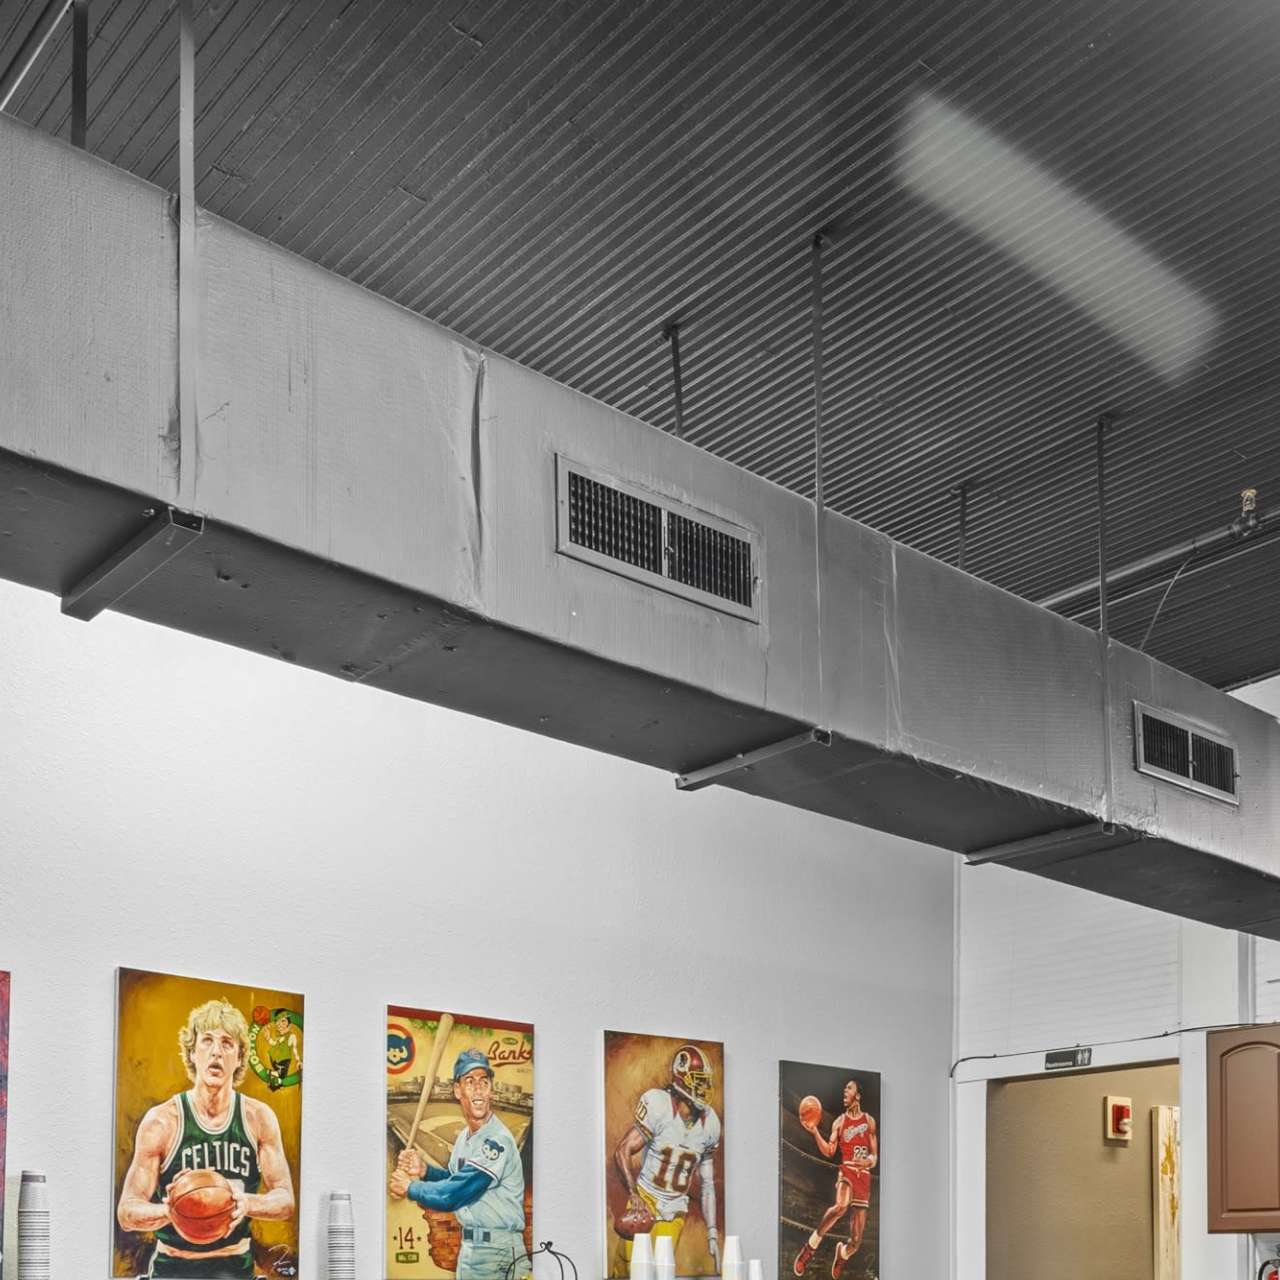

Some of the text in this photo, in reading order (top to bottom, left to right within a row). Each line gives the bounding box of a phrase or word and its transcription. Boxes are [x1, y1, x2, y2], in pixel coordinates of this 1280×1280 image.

[181, 1141, 250, 1177] CELTICS
[653, 1146, 697, 1193] 10
[398, 1227, 415, 1249] 14
